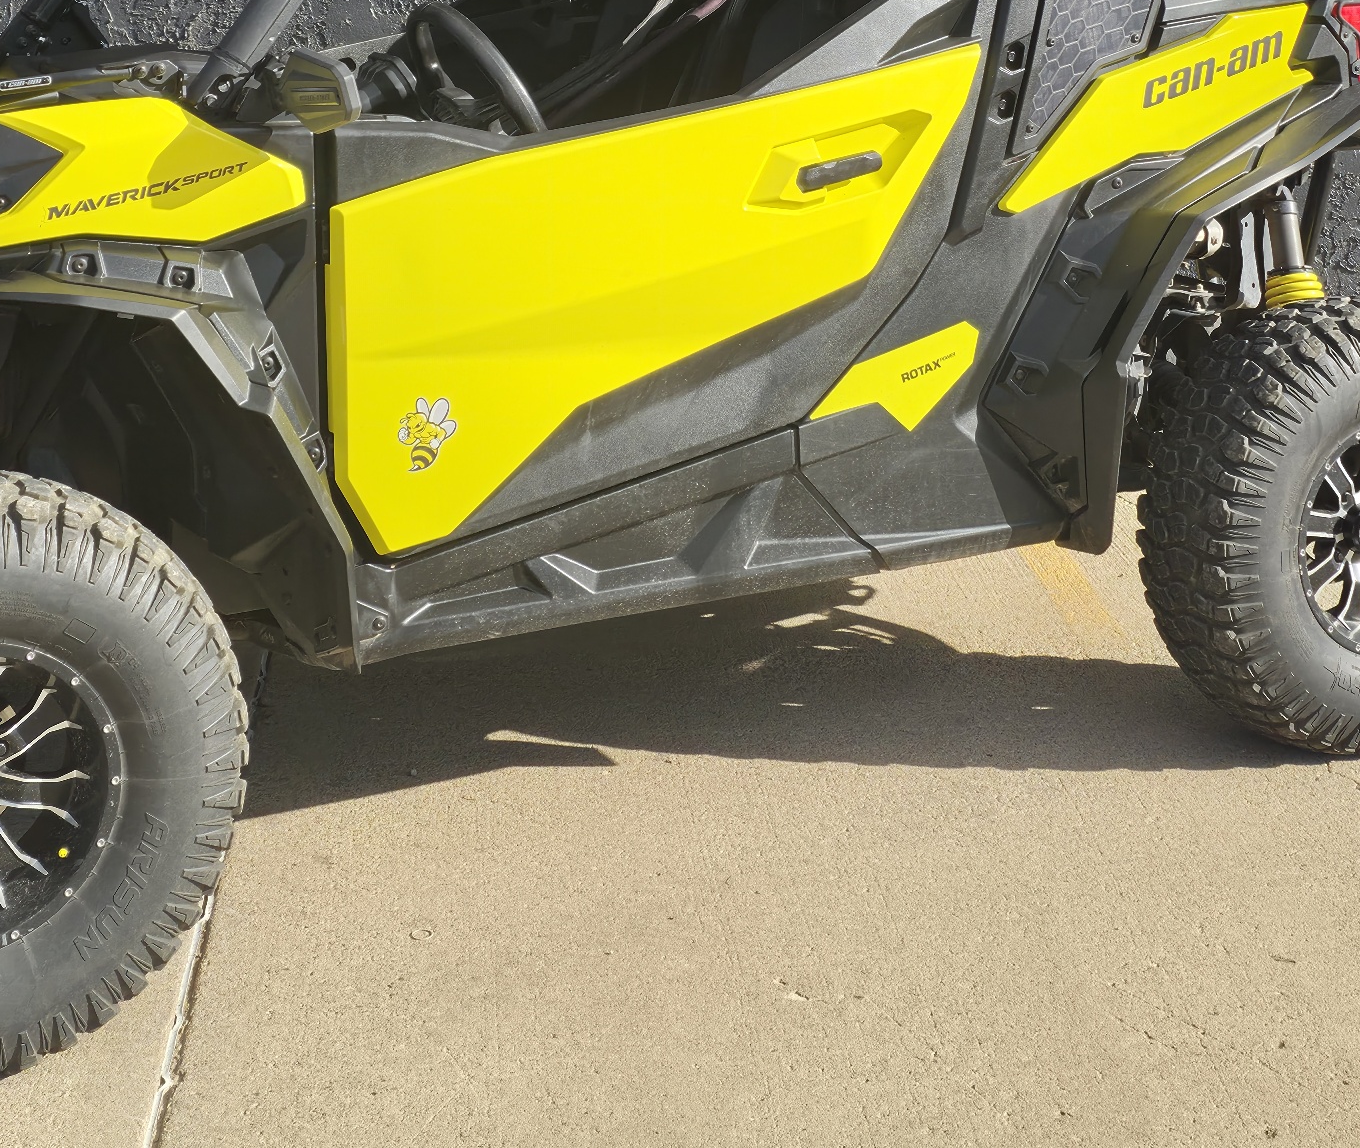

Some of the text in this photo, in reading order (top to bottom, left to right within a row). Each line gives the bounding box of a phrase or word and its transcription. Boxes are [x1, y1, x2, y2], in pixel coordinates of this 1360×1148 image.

[1142, 30, 1284, 109] can-am
[47, 161, 249, 221] MAVERICK SPORT
[900, 358, 942, 383] ROTAX
[73, 812, 170, 961] ARISUN
